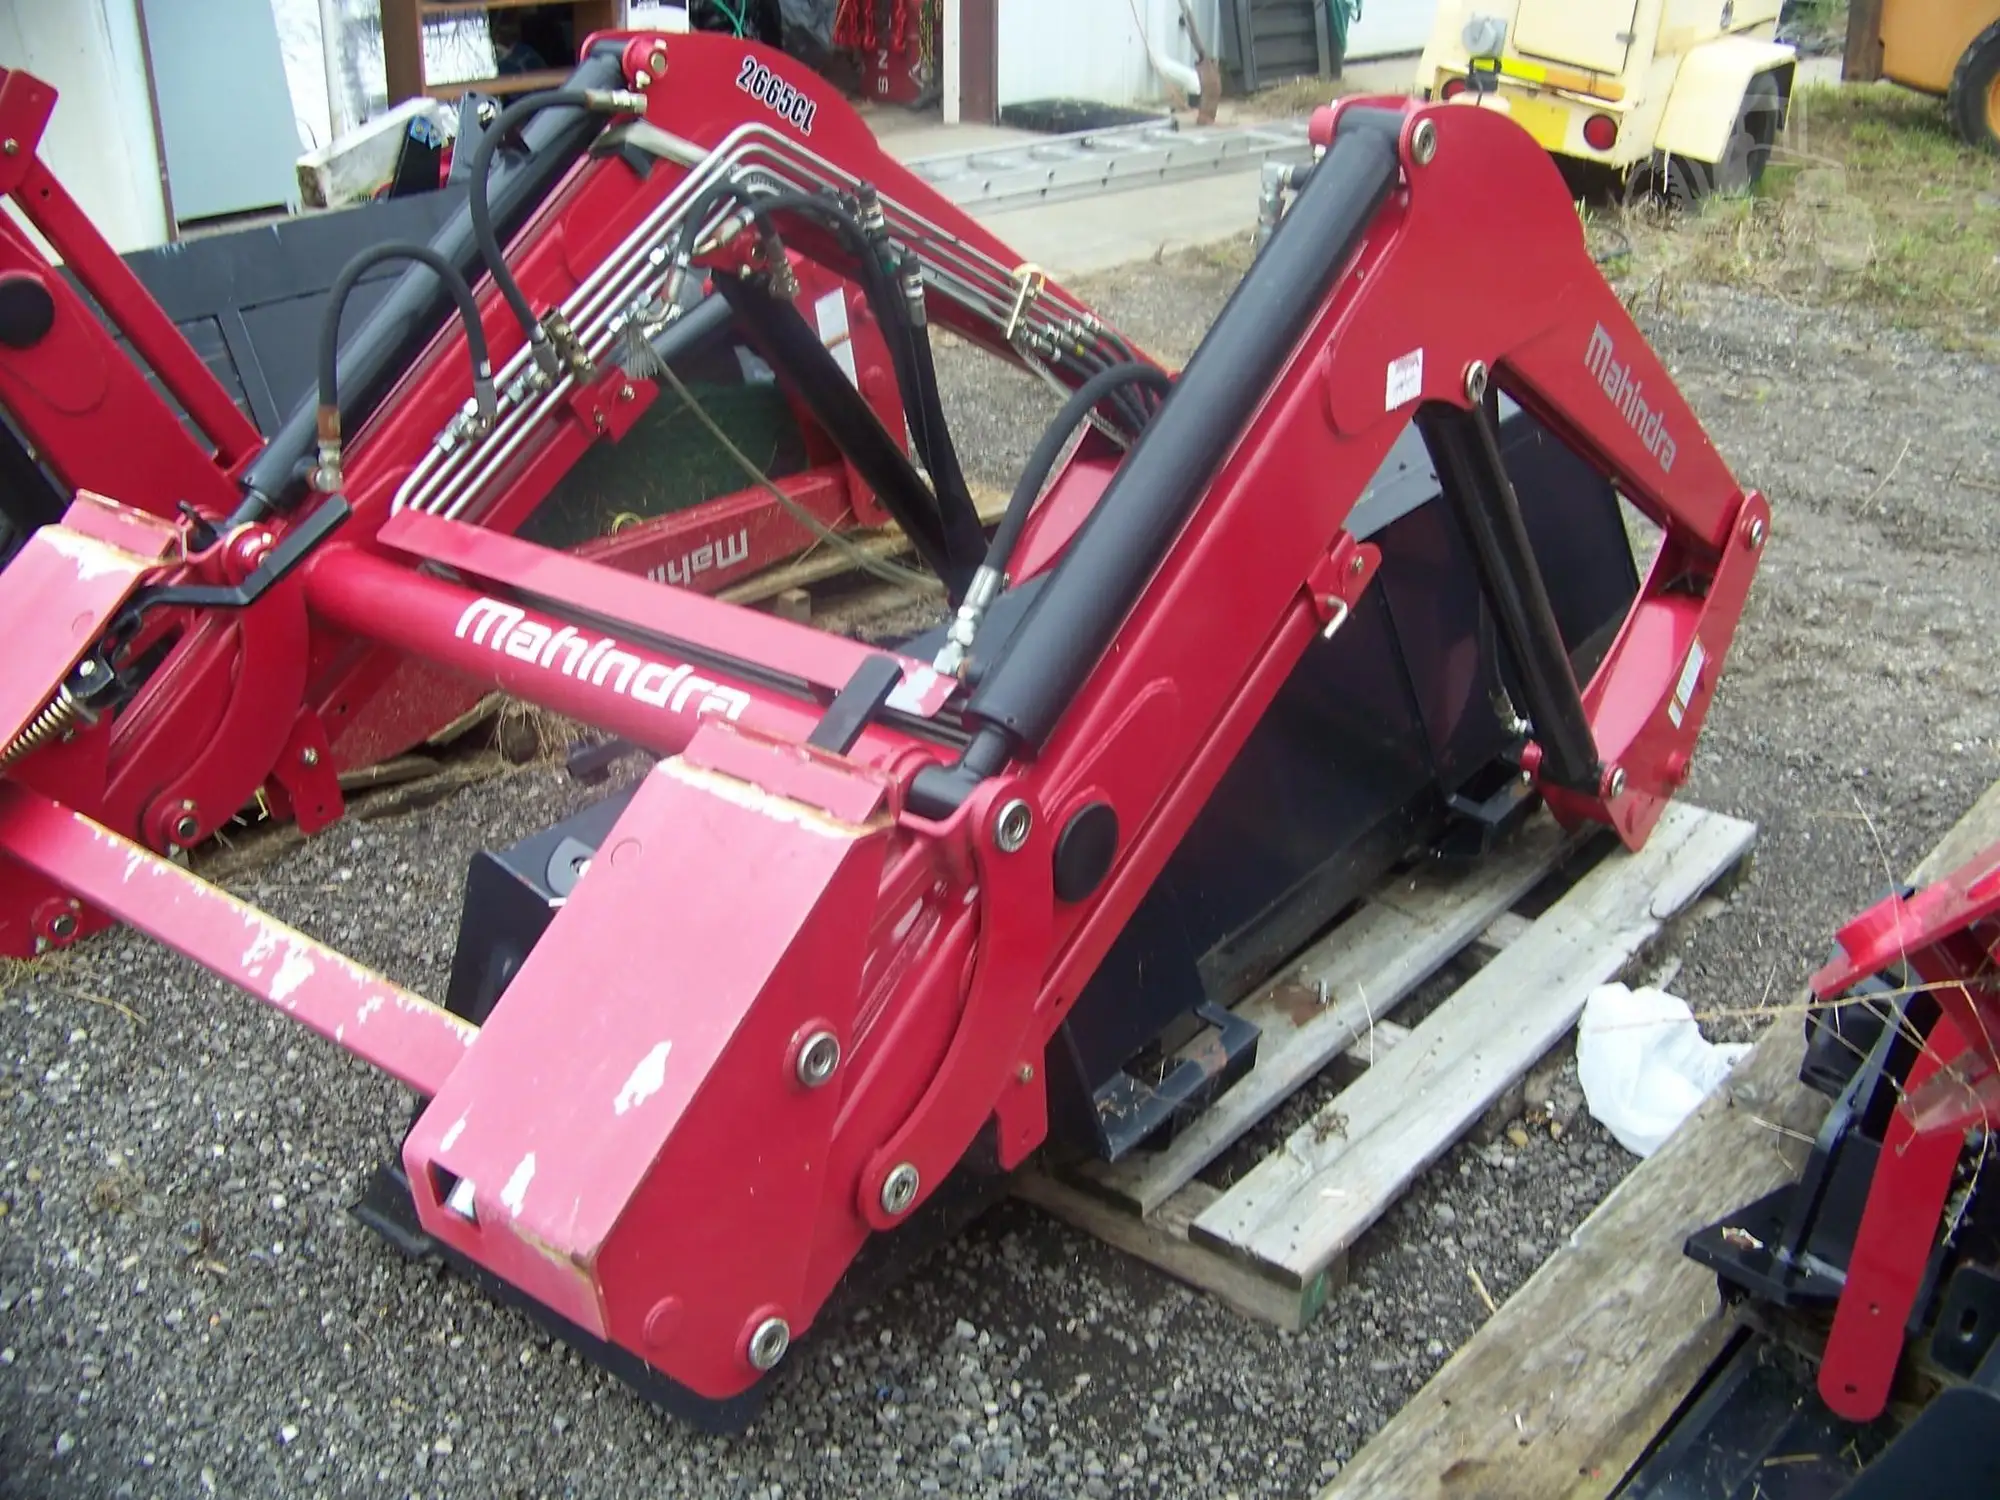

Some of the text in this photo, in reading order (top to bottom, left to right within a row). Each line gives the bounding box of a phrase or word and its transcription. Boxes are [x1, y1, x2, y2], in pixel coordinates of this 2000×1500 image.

[735, 54, 817, 137] 2665CL
[1584, 320, 1677, 475] Mahindra
[454, 596, 751, 721] Mahindra
